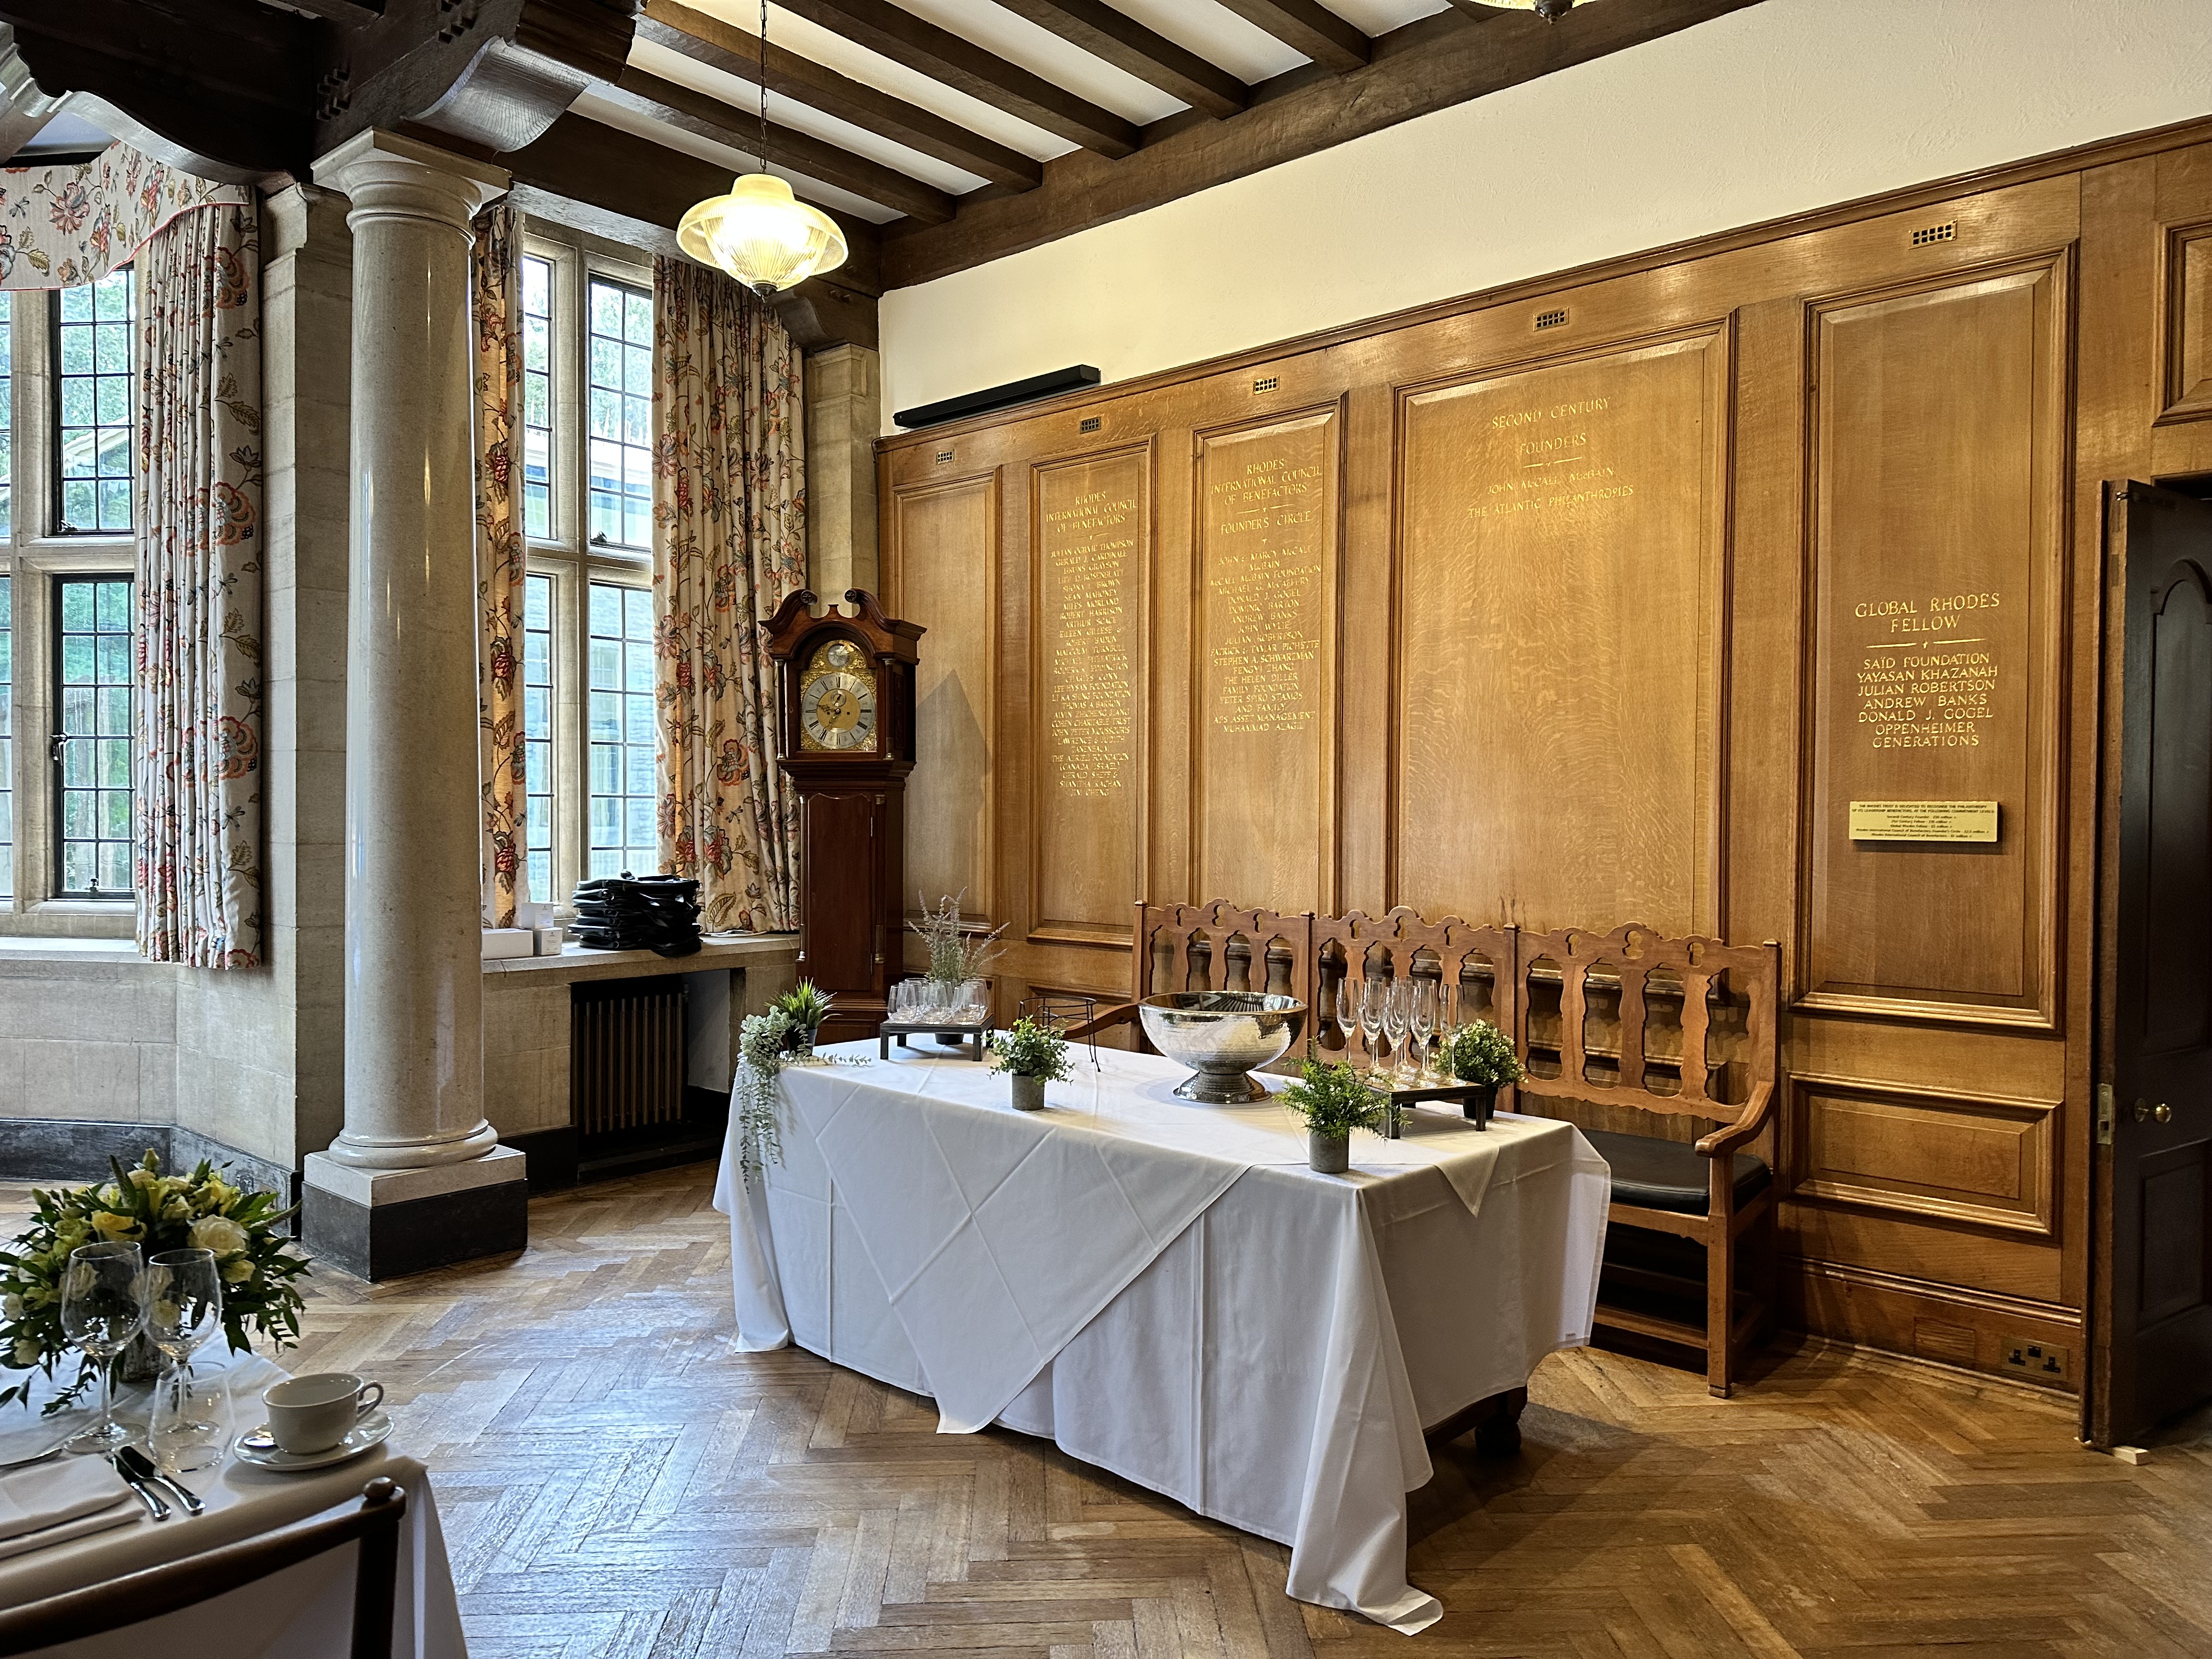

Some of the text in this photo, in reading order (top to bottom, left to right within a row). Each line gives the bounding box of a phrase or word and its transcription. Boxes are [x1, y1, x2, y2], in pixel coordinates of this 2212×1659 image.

[1492, 397, 1611, 430] SECOND CENTURY
[1520, 432, 1586, 455] FOUNDERS
[1247, 459, 1284, 475] RHODES
[1211, 466, 1322, 495] INTERNATIONAL COUNCIL
[1225, 483, 1307, 505] OF BENEFACTORS
[1488, 483, 1513, 494] JOHN
[1075, 491, 1106, 505] RHODES
[1469, 485, 1634, 518] THE ATLANTIC PHILANTHROPIES
[1046, 499, 1137, 522] INTERNATIONAL COUNCIL
[1057, 513, 1125, 533] OF BENEFACTORS
[1277, 511, 1311, 526] CIRCLE
[1092, 550, 1127, 561] CARDINALE
[1088, 561, 1119, 571] GRAYSON
[1855, 593, 2000, 618] GLOBAL RHODES
[1891, 614, 1961, 633] FELLOW
[1225, 631, 1303, 645] JULIAN ROBERTSON
[1210, 647, 1239, 656] PATRICK
[1251, 644, 1277, 653] TAMAR
[1283, 640, 1320, 651] PICHETTE
[1214, 656, 1249, 666] STEPHEN
[1261, 651, 1314, 663] SCHWARZMAN
[1864, 653, 1990, 670] SAÏD FOUNDATION
[1267, 663, 1294, 672] ZHANG
[1857, 665, 1997, 683] YAYASAN KHAZANAH
[1224, 676, 1238, 685] THE
[1272, 673, 1297, 682] DILLER
[1254, 683, 1299, 692] FOUNDATION
[1858, 680, 1995, 697] JULIAN ROBERTSON
[1221, 696, 1242, 704] PETER
[1246, 694, 1267, 702] SPIRO
[1864, 693, 1987, 709] ANDREW BANKS
[1257, 703, 1286, 712] FAMILY
[1859, 707, 1994, 723] DONALD J. GOGEL
[1231, 714, 1254, 723] ASSET
[1257, 711, 1315, 721] MANAGEMENT
[1223, 724, 1269, 732] MUHAMMAD
[1876, 721, 1976, 735] OPPENHEIMER
[1872, 735, 1979, 748] GENERATIONS
